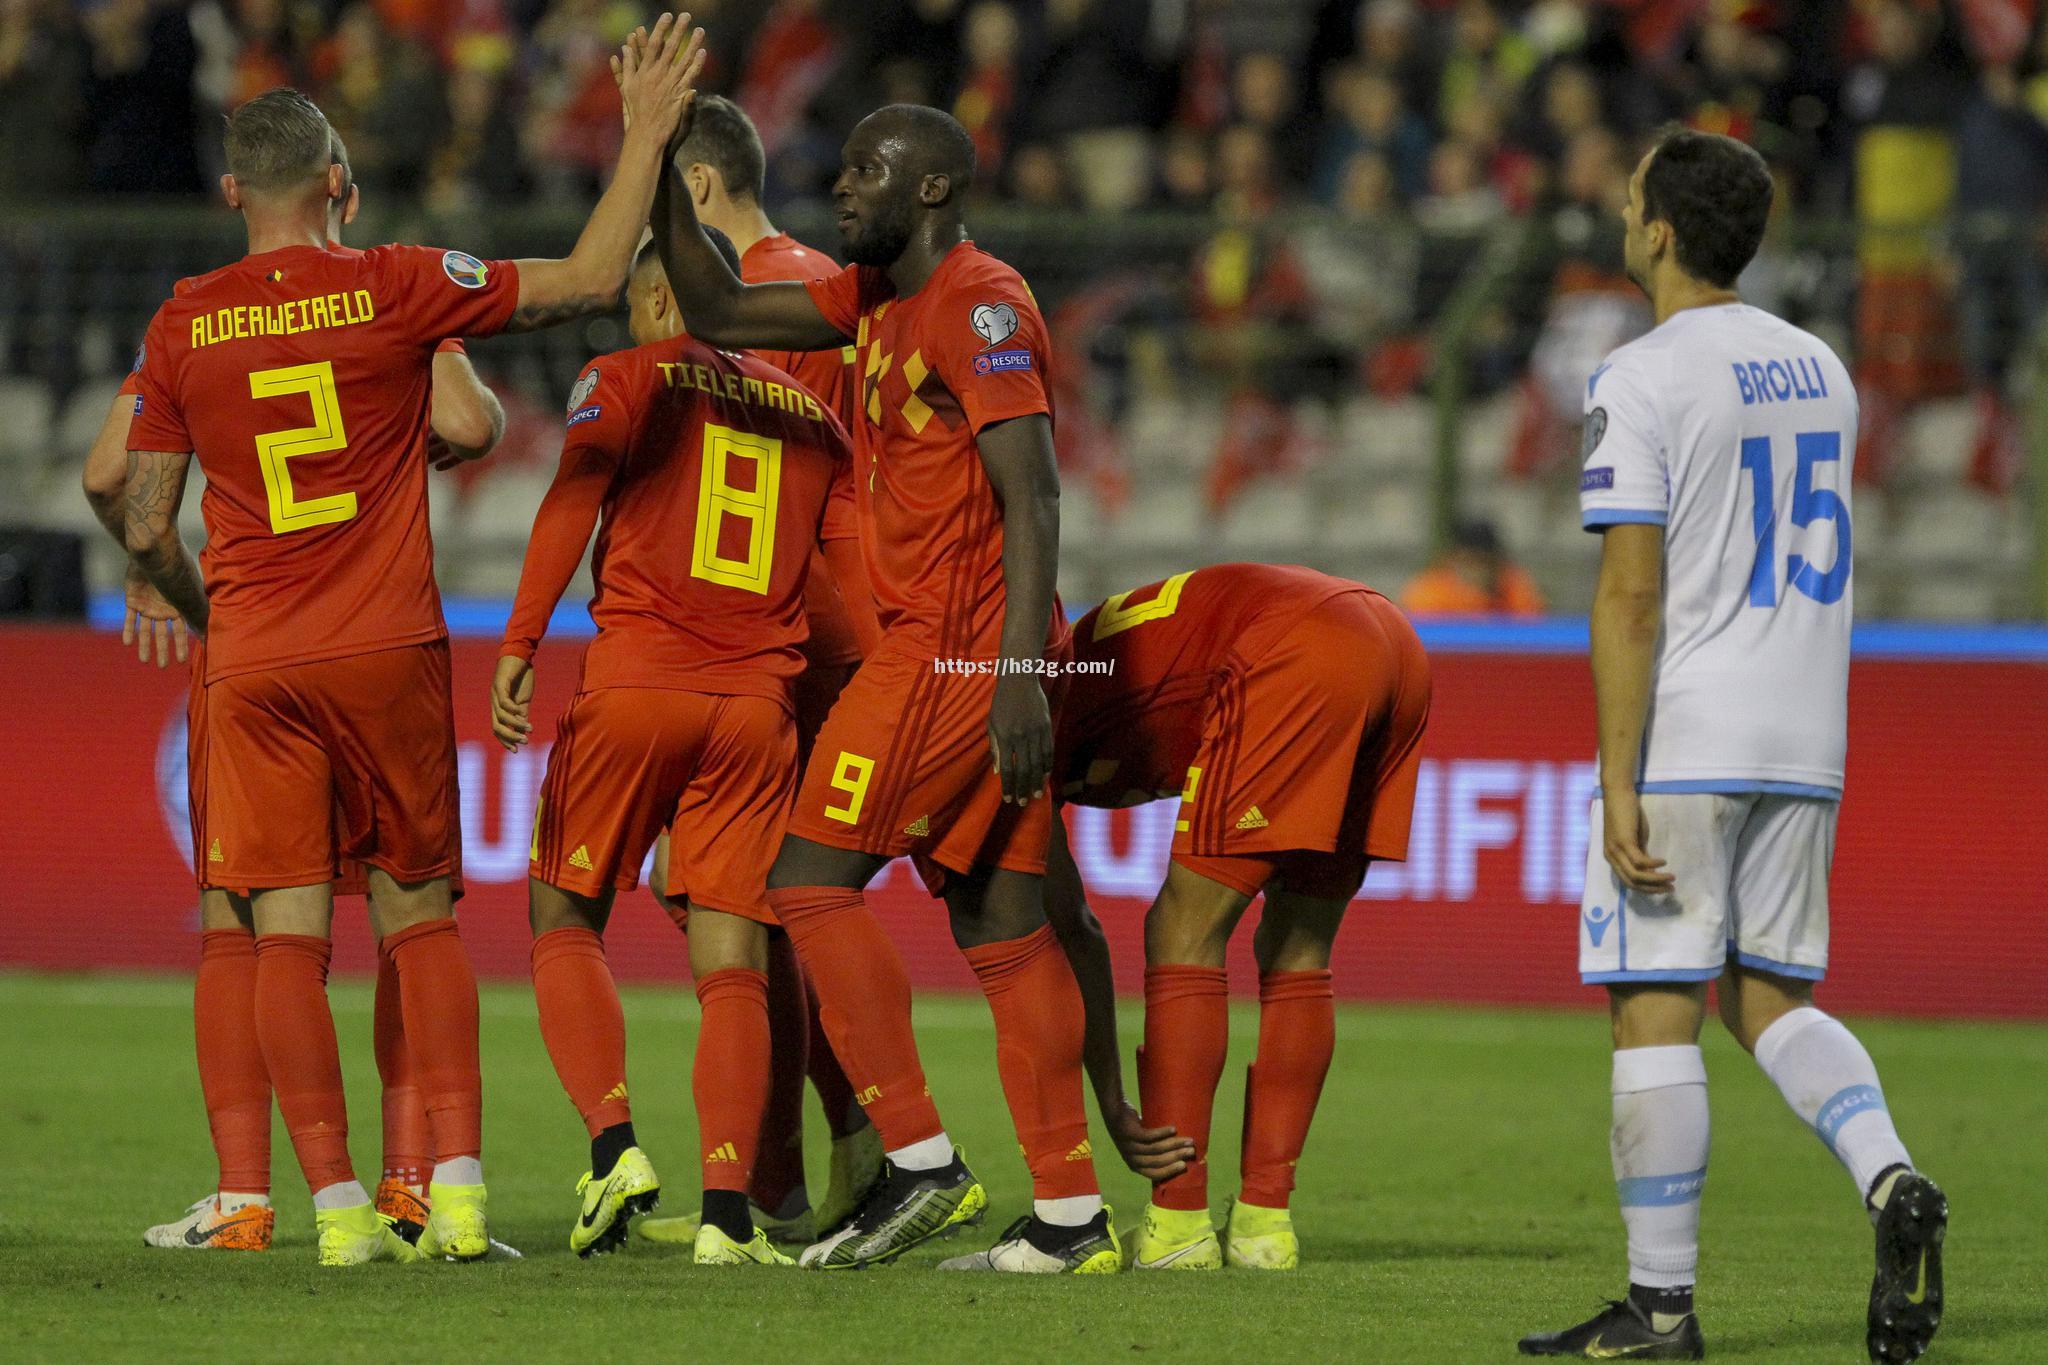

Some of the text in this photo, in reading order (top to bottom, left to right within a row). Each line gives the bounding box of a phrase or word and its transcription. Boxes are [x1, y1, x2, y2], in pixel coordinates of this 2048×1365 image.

[191, 290, 374, 349] ALDERWEIRELD
[657, 362, 822, 422] TIELEMANS
[992, 356, 1030, 367] RESPECT
[1732, 357, 1828, 405] BROLLI
[249, 360, 357, 534] 2
[690, 422, 782, 596] 8
[1741, 431, 1851, 608] 15
[824, 751, 875, 825] 9
